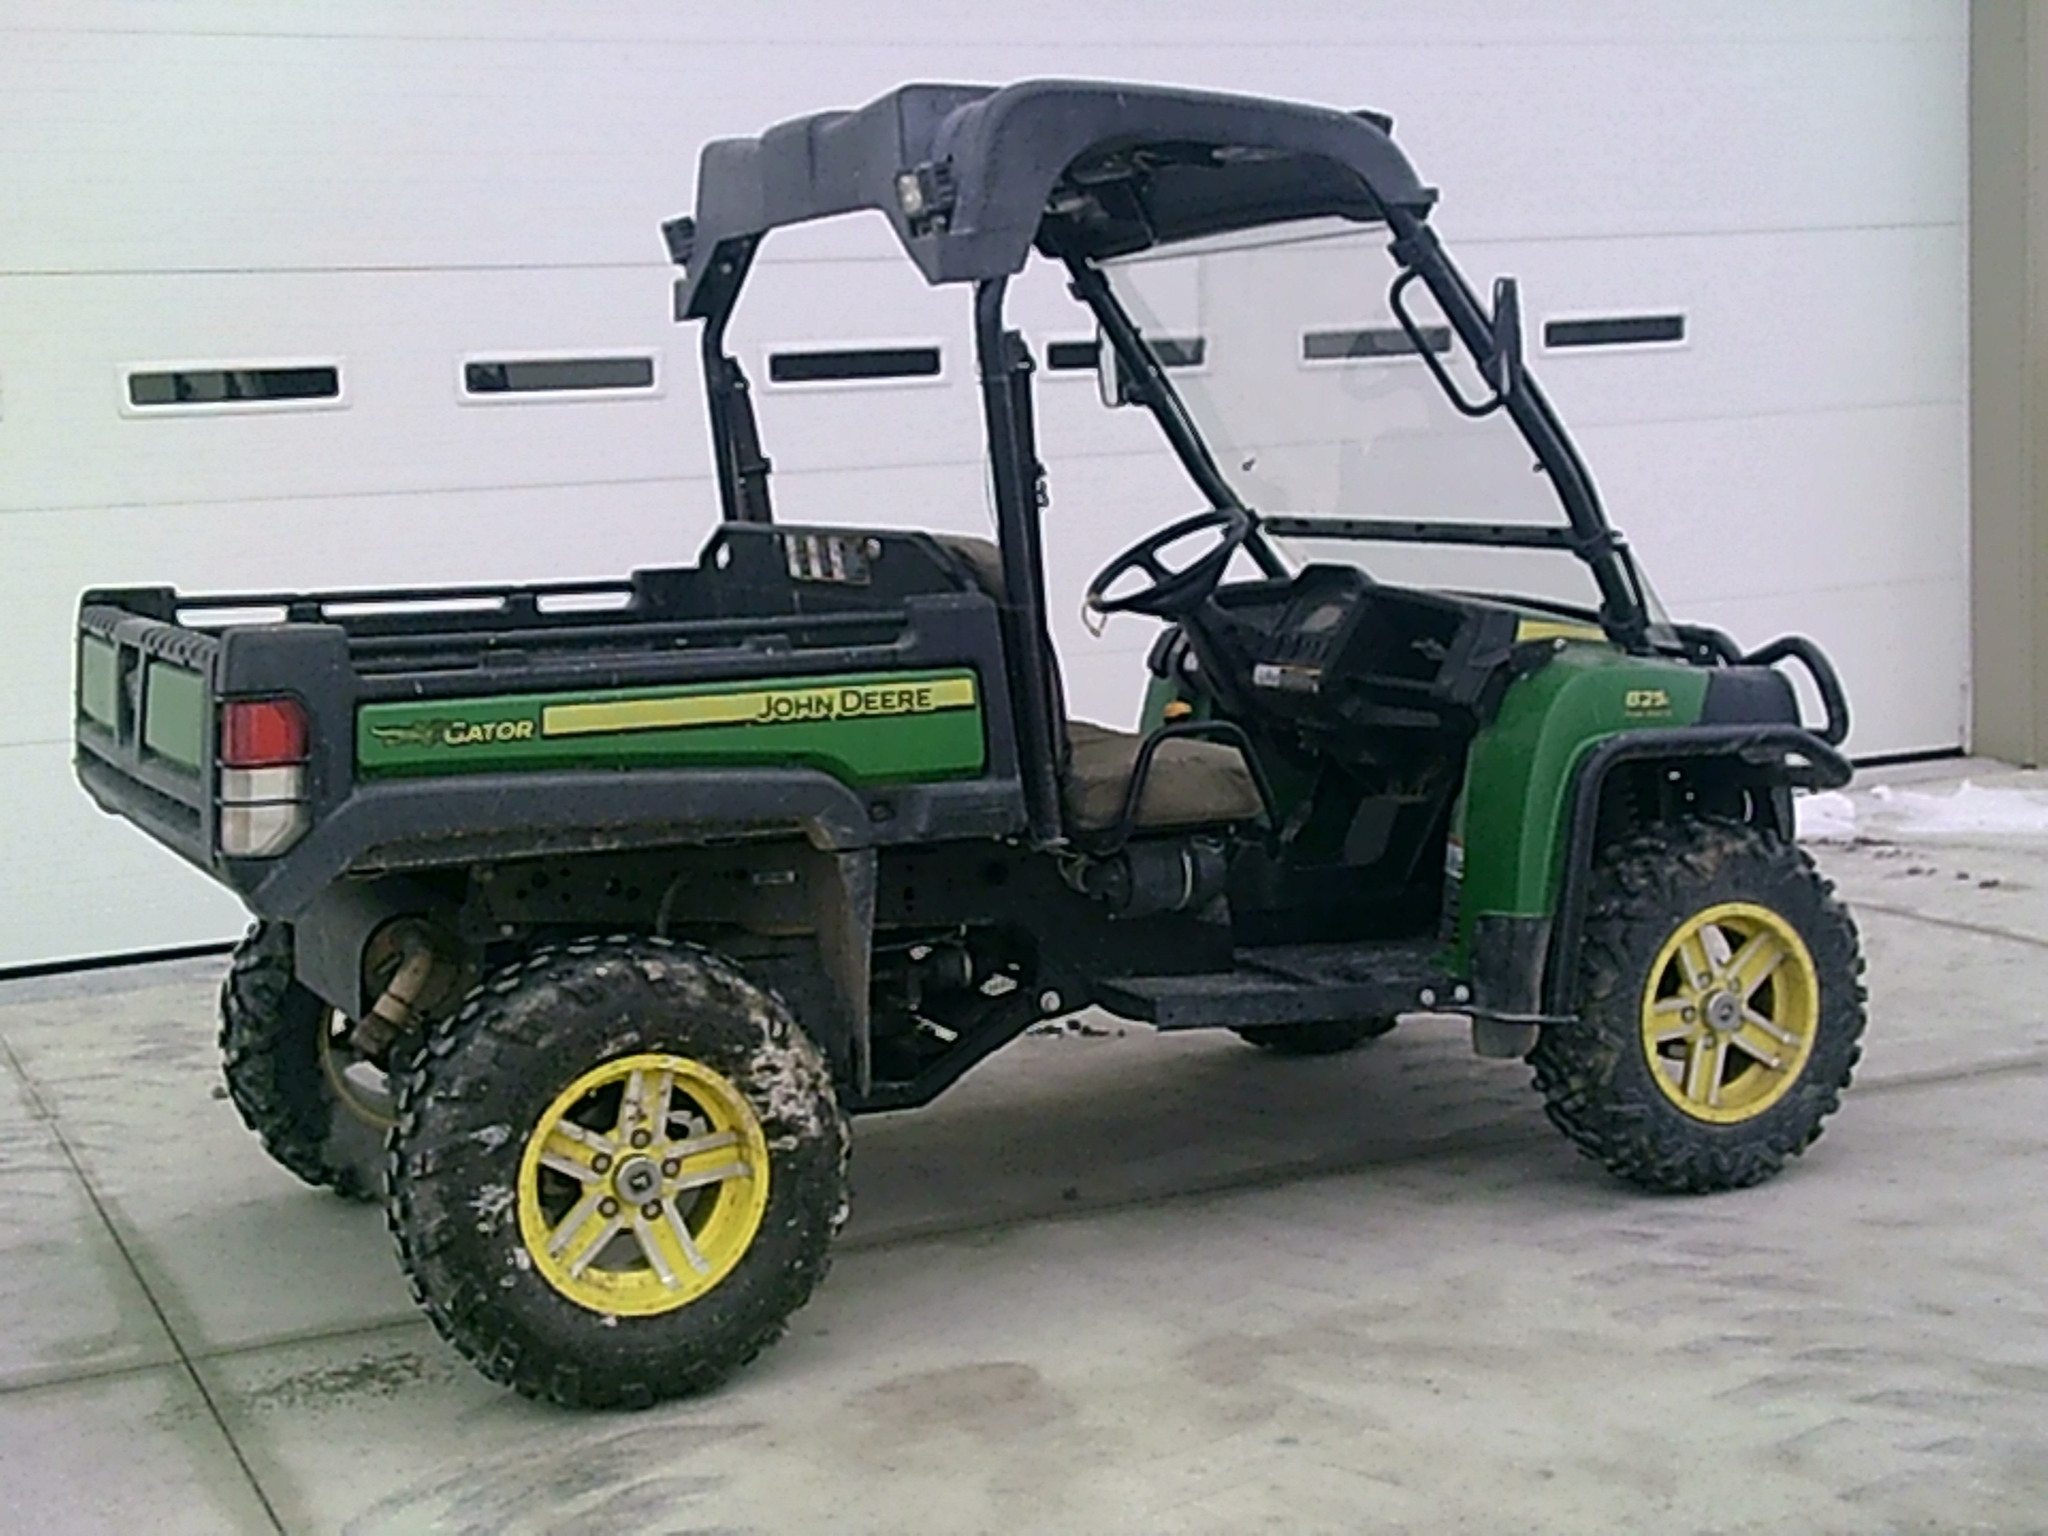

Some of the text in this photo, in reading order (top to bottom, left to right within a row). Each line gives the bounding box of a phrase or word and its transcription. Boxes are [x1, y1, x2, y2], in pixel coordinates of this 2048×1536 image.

[757, 687, 933, 719] JOHN DEERE
[443, 719, 535, 745] GATOR
